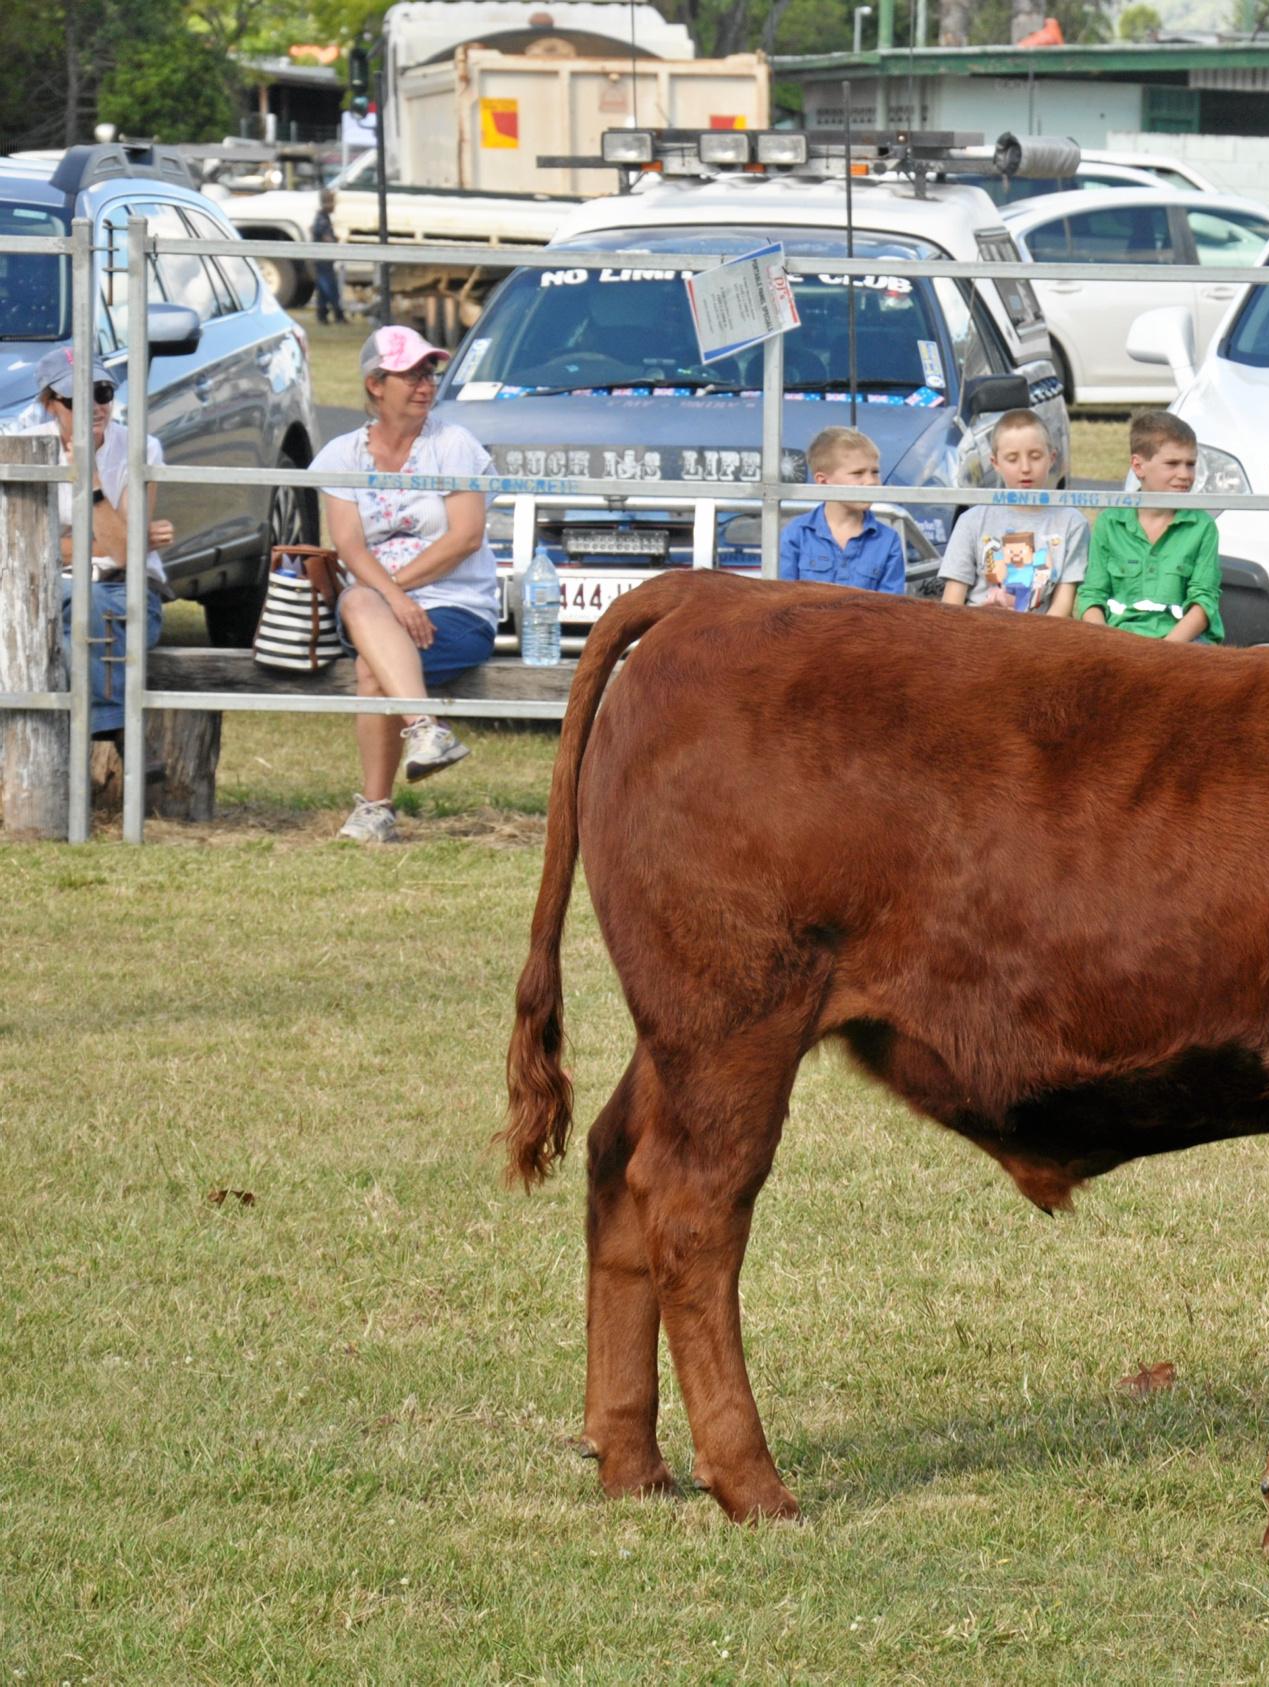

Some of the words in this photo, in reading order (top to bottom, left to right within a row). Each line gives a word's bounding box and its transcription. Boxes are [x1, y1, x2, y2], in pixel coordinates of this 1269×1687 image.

[540, 269, 588, 287] NO
[506, 450, 590, 478] SUCH
[682, 450, 761, 480] LIFE
